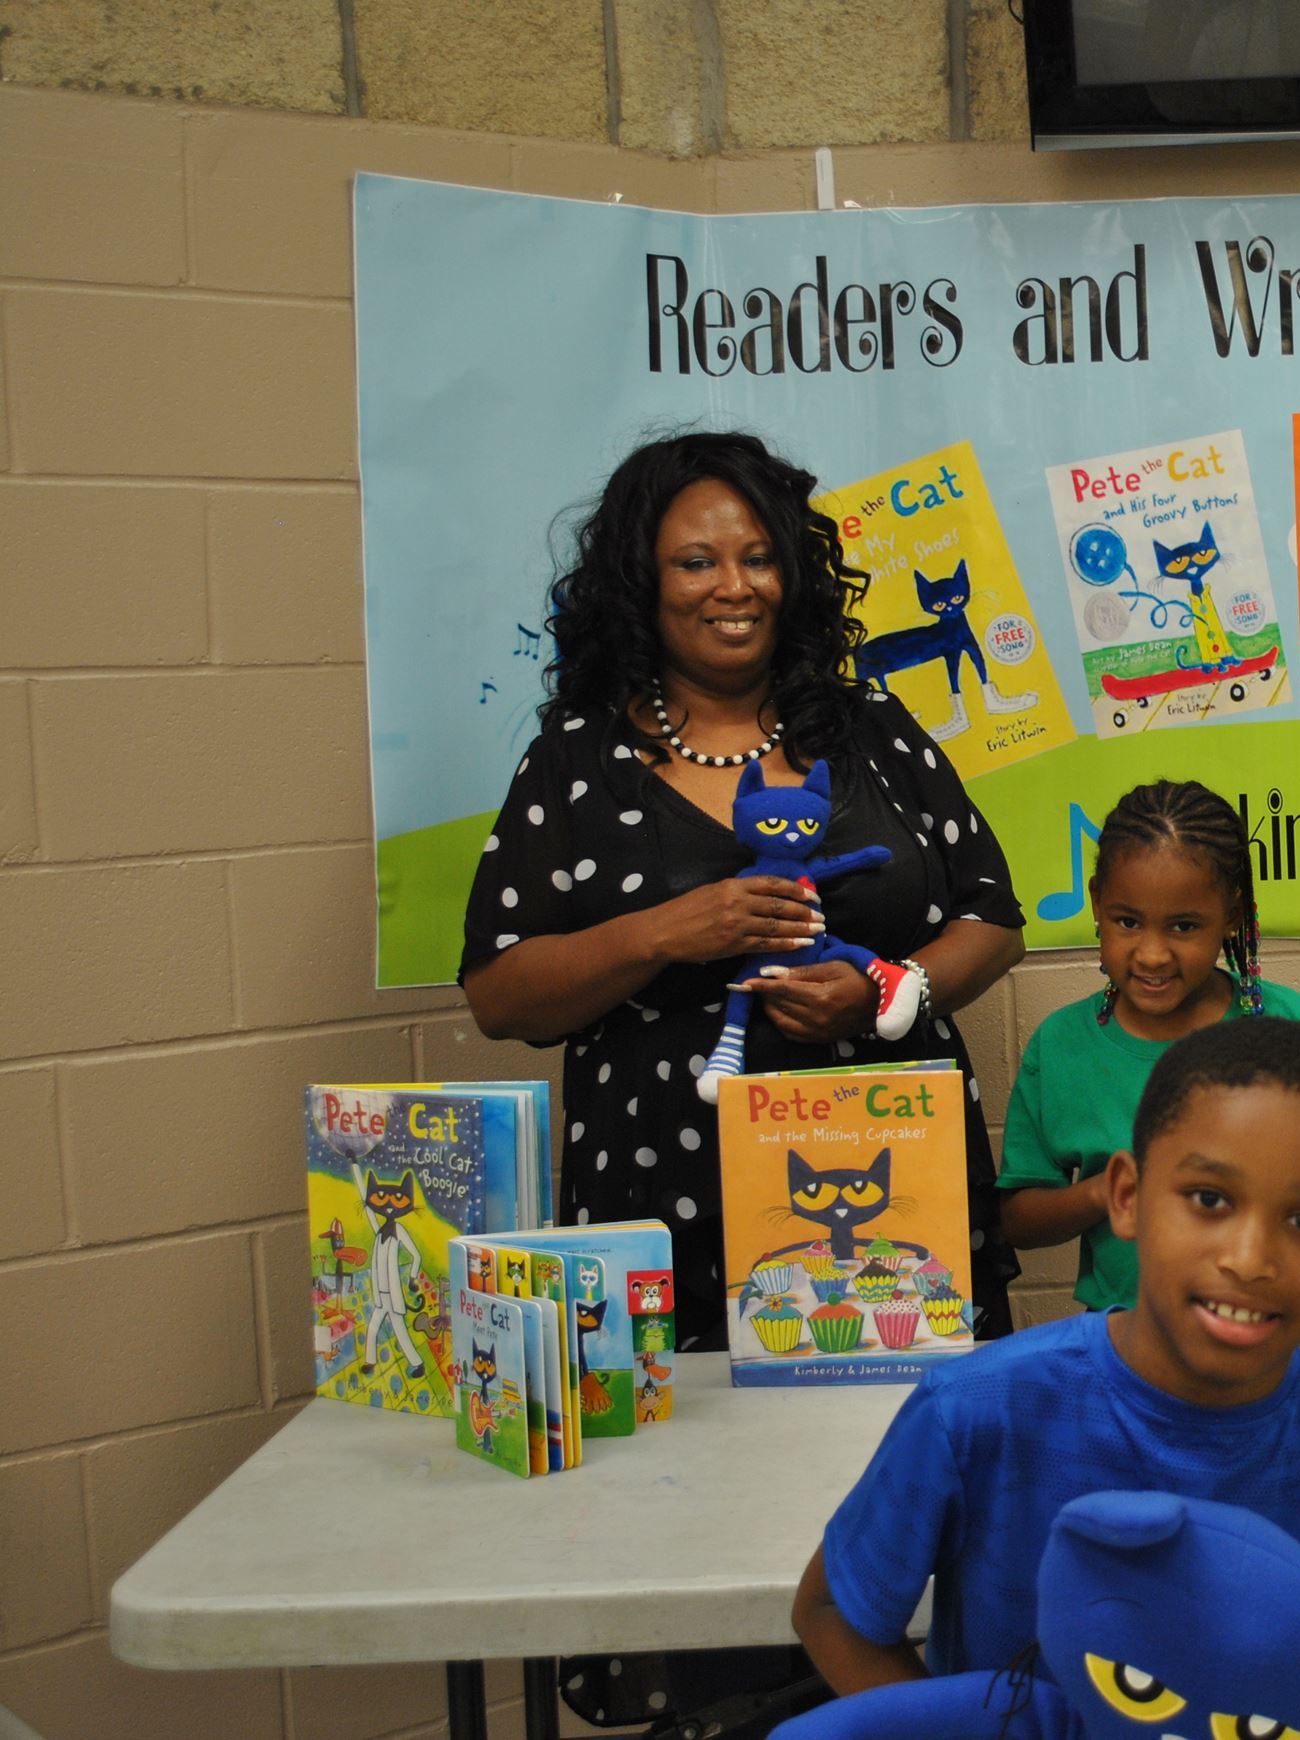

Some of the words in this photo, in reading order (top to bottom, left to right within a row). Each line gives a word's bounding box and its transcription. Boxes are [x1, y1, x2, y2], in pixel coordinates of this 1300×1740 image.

[645, 253, 964, 376] Readers
[1012, 243, 1150, 366] and
[1070, 466, 1141, 503] Pete
[1141, 458, 1163, 475] the
[1167, 445, 1225, 482] Cat
[860, 496, 886, 516] the
[890, 465, 964, 517] Cat
[1103, 502, 1126, 520] and
[1131, 496, 1146, 513] His
[1152, 493, 1177, 507] Four
[1143, 506, 1187, 528] Groovy
[1192, 493, 1238, 512] Buttons
[864, 532, 896, 558] My
[913, 528, 960, 562] Shoes
[1232, 603, 1259, 616] FREE
[1234, 593, 1251, 604] FOR
[997, 620, 1016, 631] FOR
[1236, 614, 1258, 624] SONG
[995, 628, 1025, 644] FREE
[1000, 642, 1024, 653] SONG
[1167, 704, 1185, 715] Eric
[986, 736, 1009, 752] Eric
[1011, 722, 1047, 743] Litwin
[748, 1084, 832, 1123] Pete
[833, 1085, 860, 1103] the
[865, 1083, 935, 1118] Cat
[324, 1093, 385, 1135] Pete
[408, 1103, 459, 1143] Cat
[759, 1132, 780, 1143] and
[813, 1127, 860, 1145] Missing
[866, 1126, 927, 1143] Cupcakes
[415, 1147, 444, 1165] Cool
[449, 1153, 472, 1173] Cat
[422, 1169, 467, 1198] Boogie
[459, 1289, 483, 1320] Pete
[491, 1303, 510, 1331] Cat
[795, 1366, 844, 1376] Kimberly
[848, 1365, 855, 1375] &
[860, 1365, 890, 1374] James
